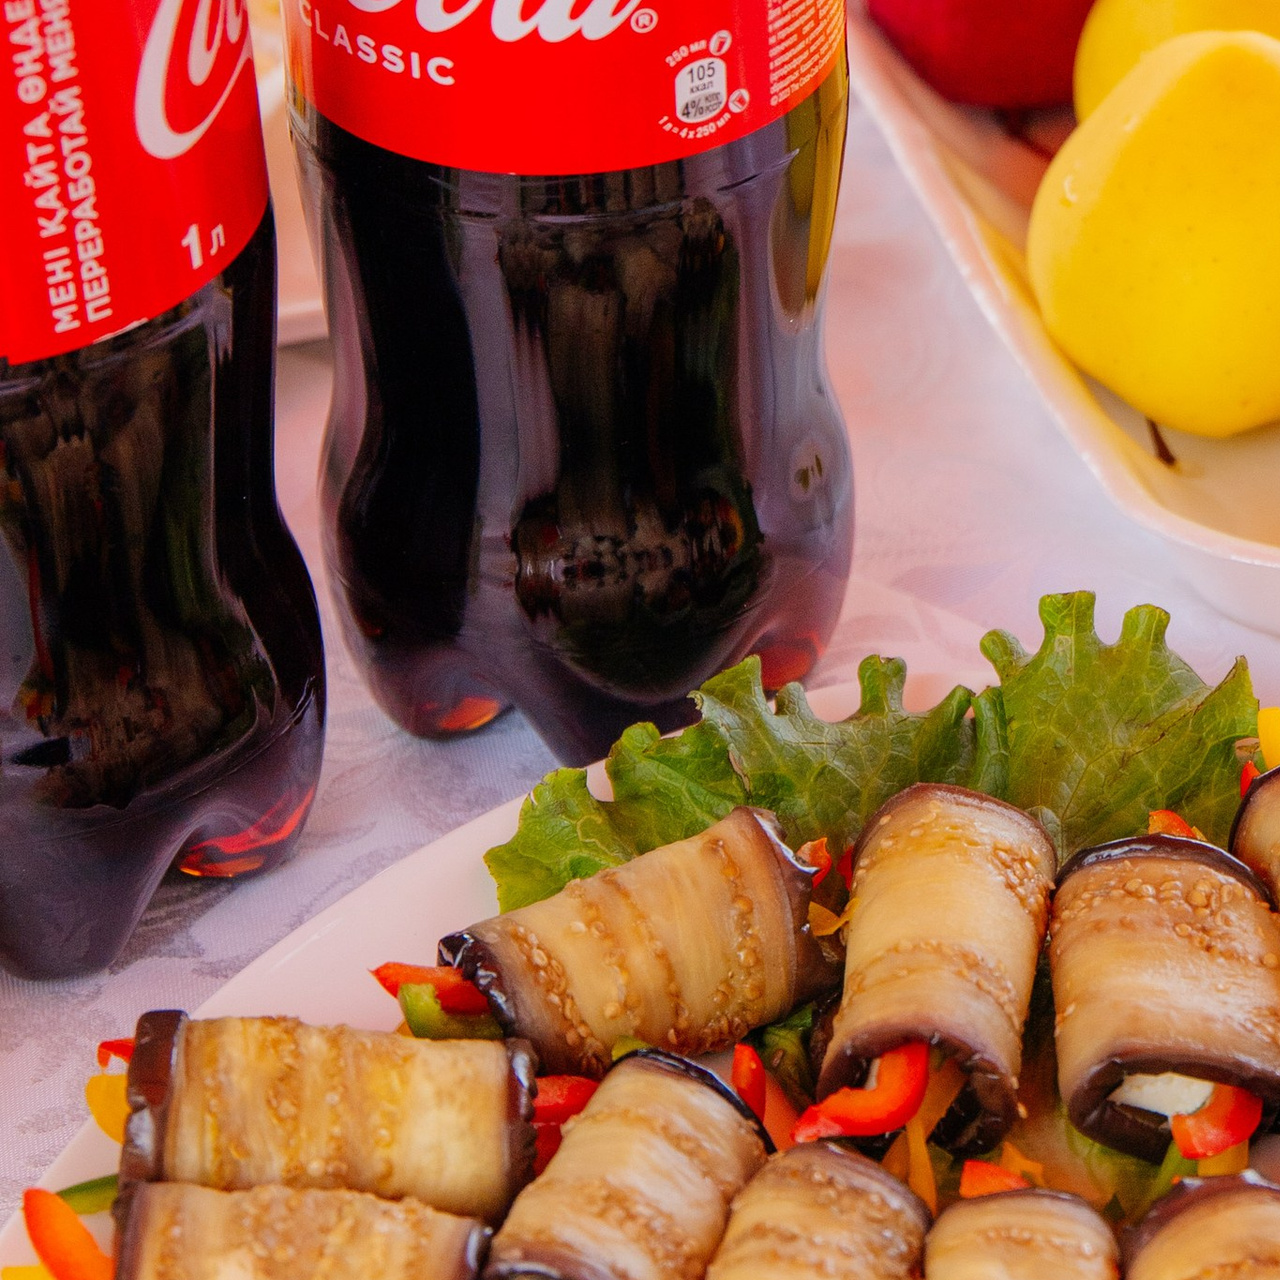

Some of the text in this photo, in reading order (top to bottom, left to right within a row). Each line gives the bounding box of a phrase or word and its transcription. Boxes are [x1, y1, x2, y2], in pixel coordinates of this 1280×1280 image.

[665, 45, 689, 67] 250
[687, 61, 716, 83] 105
[681, 98, 704, 119] 4%
[695, 122, 716, 138] 250
[23, 111, 69, 238] ҚАЙТА
[49, 85, 113, 323] ПЕРЕРАБОТАЙ
[181, 223, 226, 270] 1 л
[43, 246, 80, 333] МЕНІ
